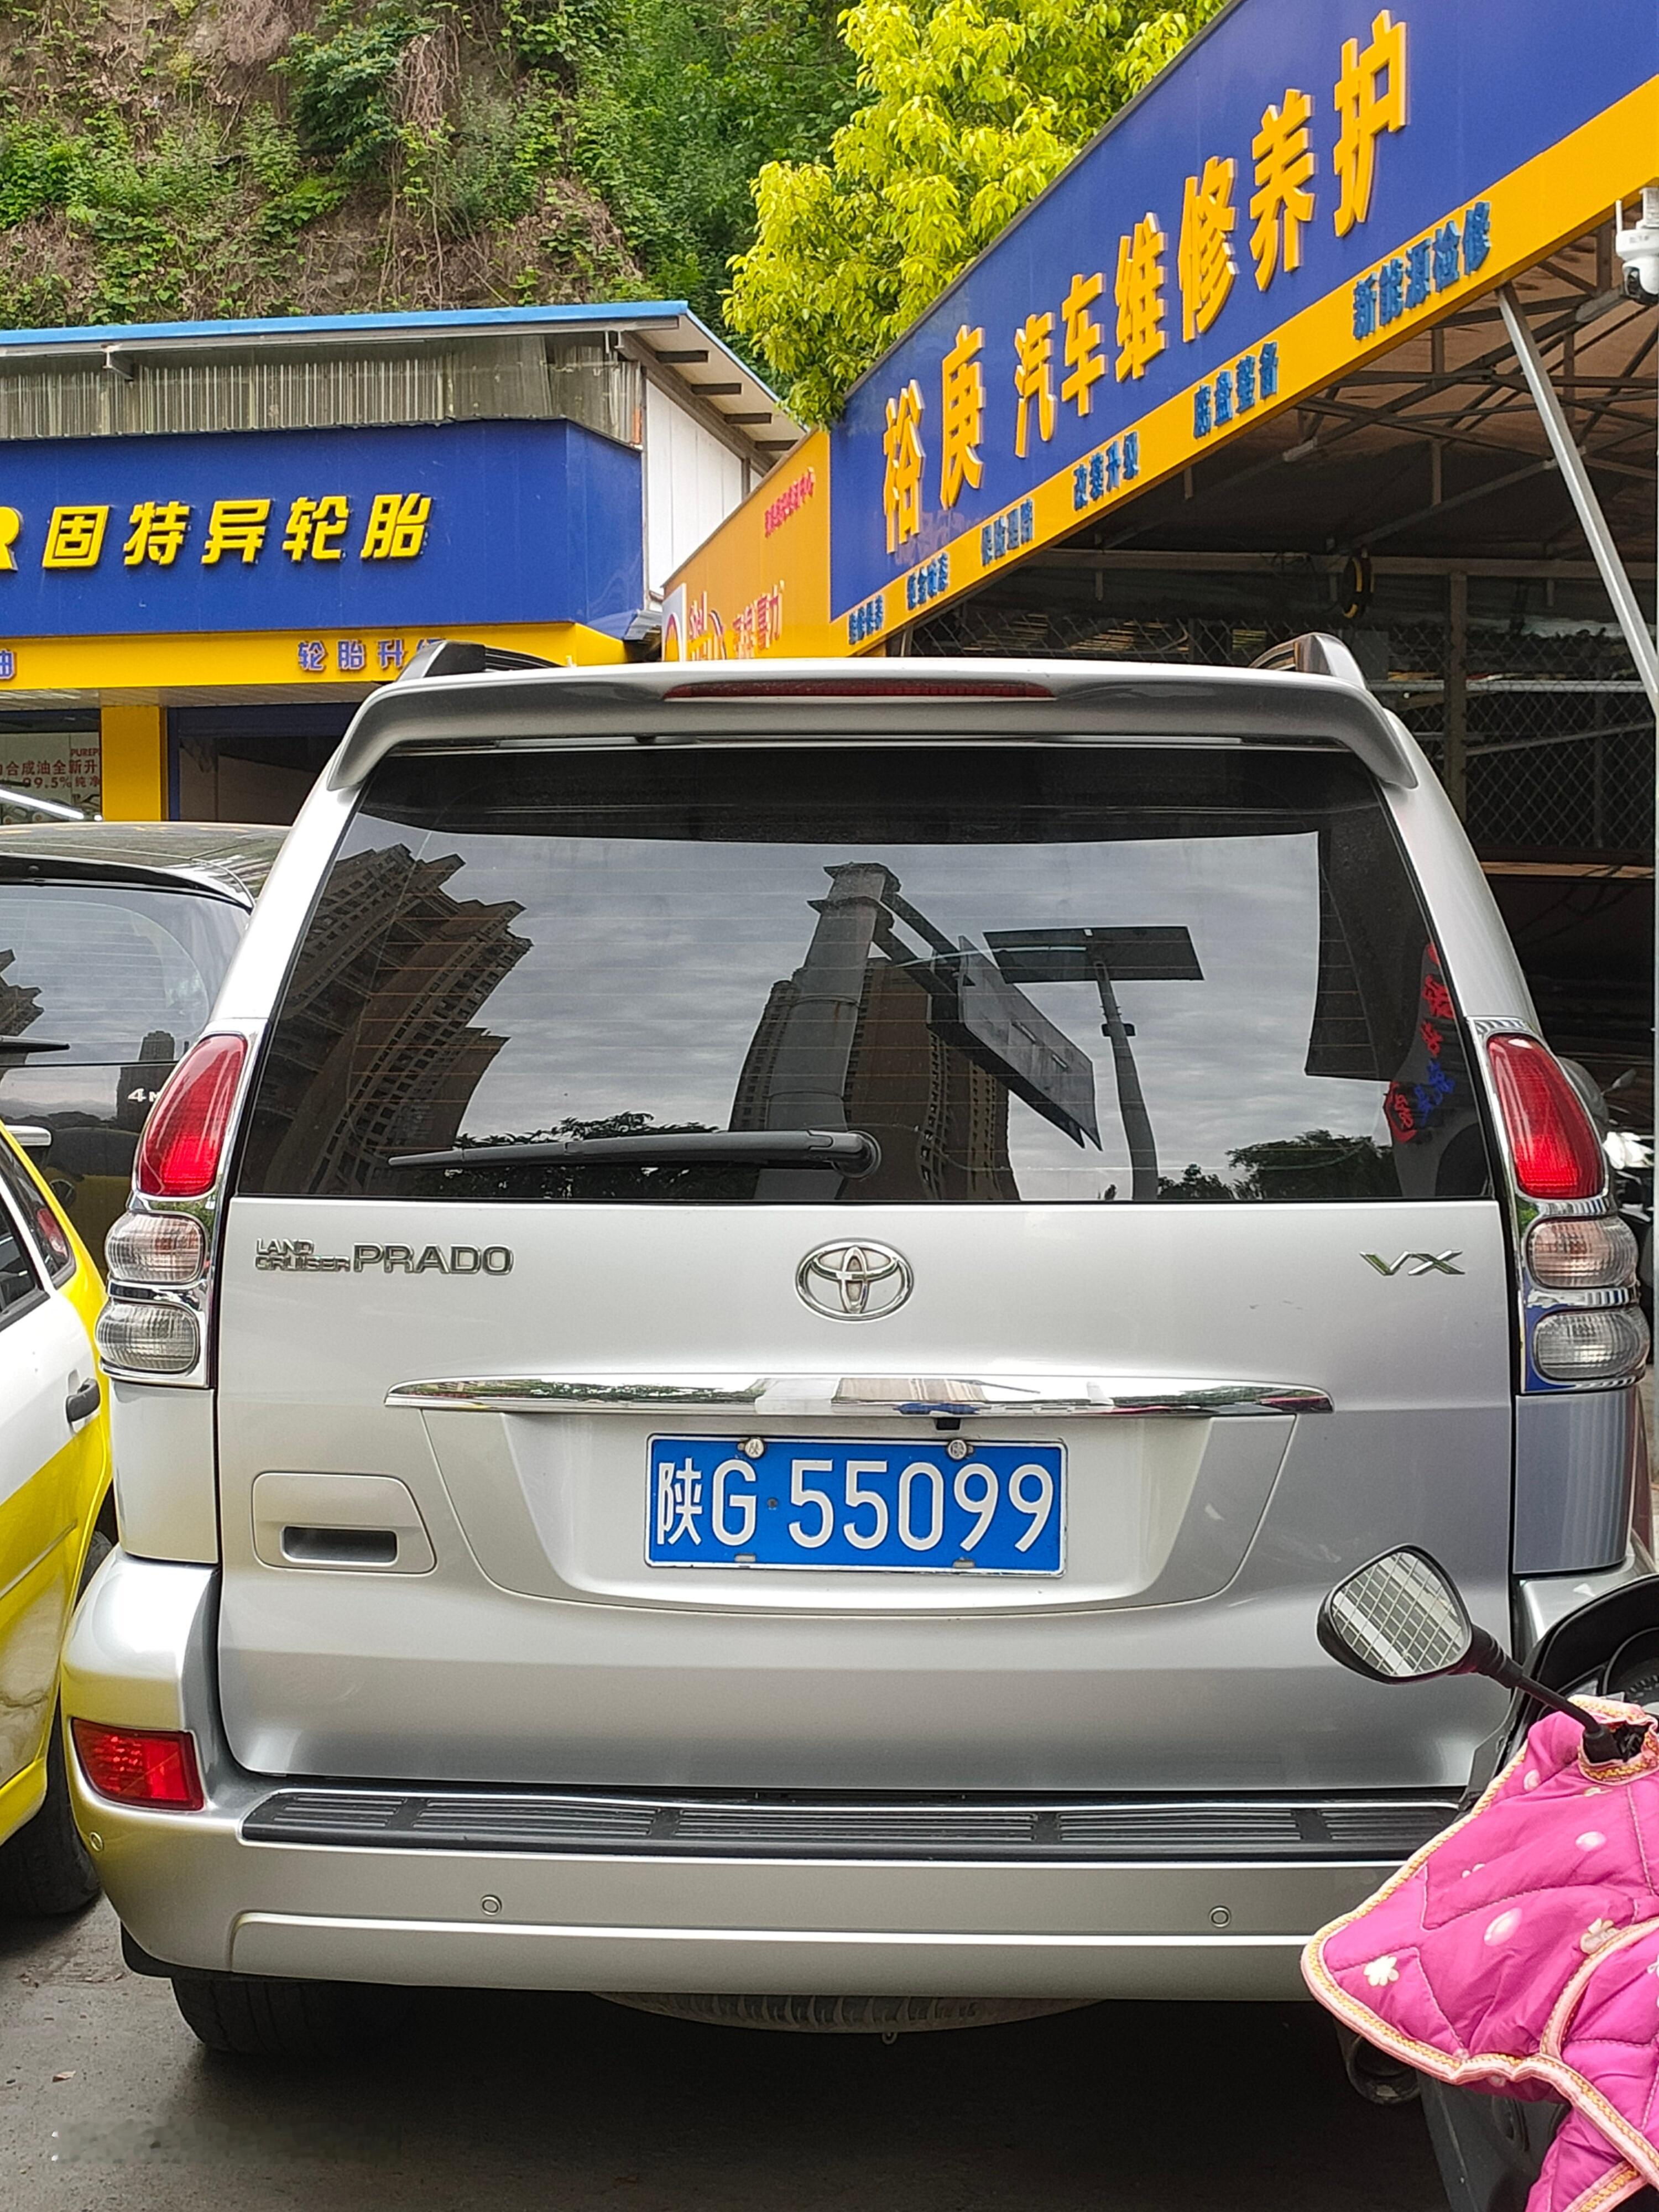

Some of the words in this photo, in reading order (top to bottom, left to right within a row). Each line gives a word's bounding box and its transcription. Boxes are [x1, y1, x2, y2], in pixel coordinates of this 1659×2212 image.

[1015, 9, 1411, 459] 汽车维修养护
[42, 492, 432, 569] 固特异轮胎
[298, 638, 444, 671] 轮胎升
[0, 760, 97, 776] 合成油全新升
[257, 1238, 315, 1255] LAND
[353, 1242, 514, 1276] PRADO
[255, 1255, 351, 1272] CRUISER
[1359, 1250, 1465, 1276] VX
